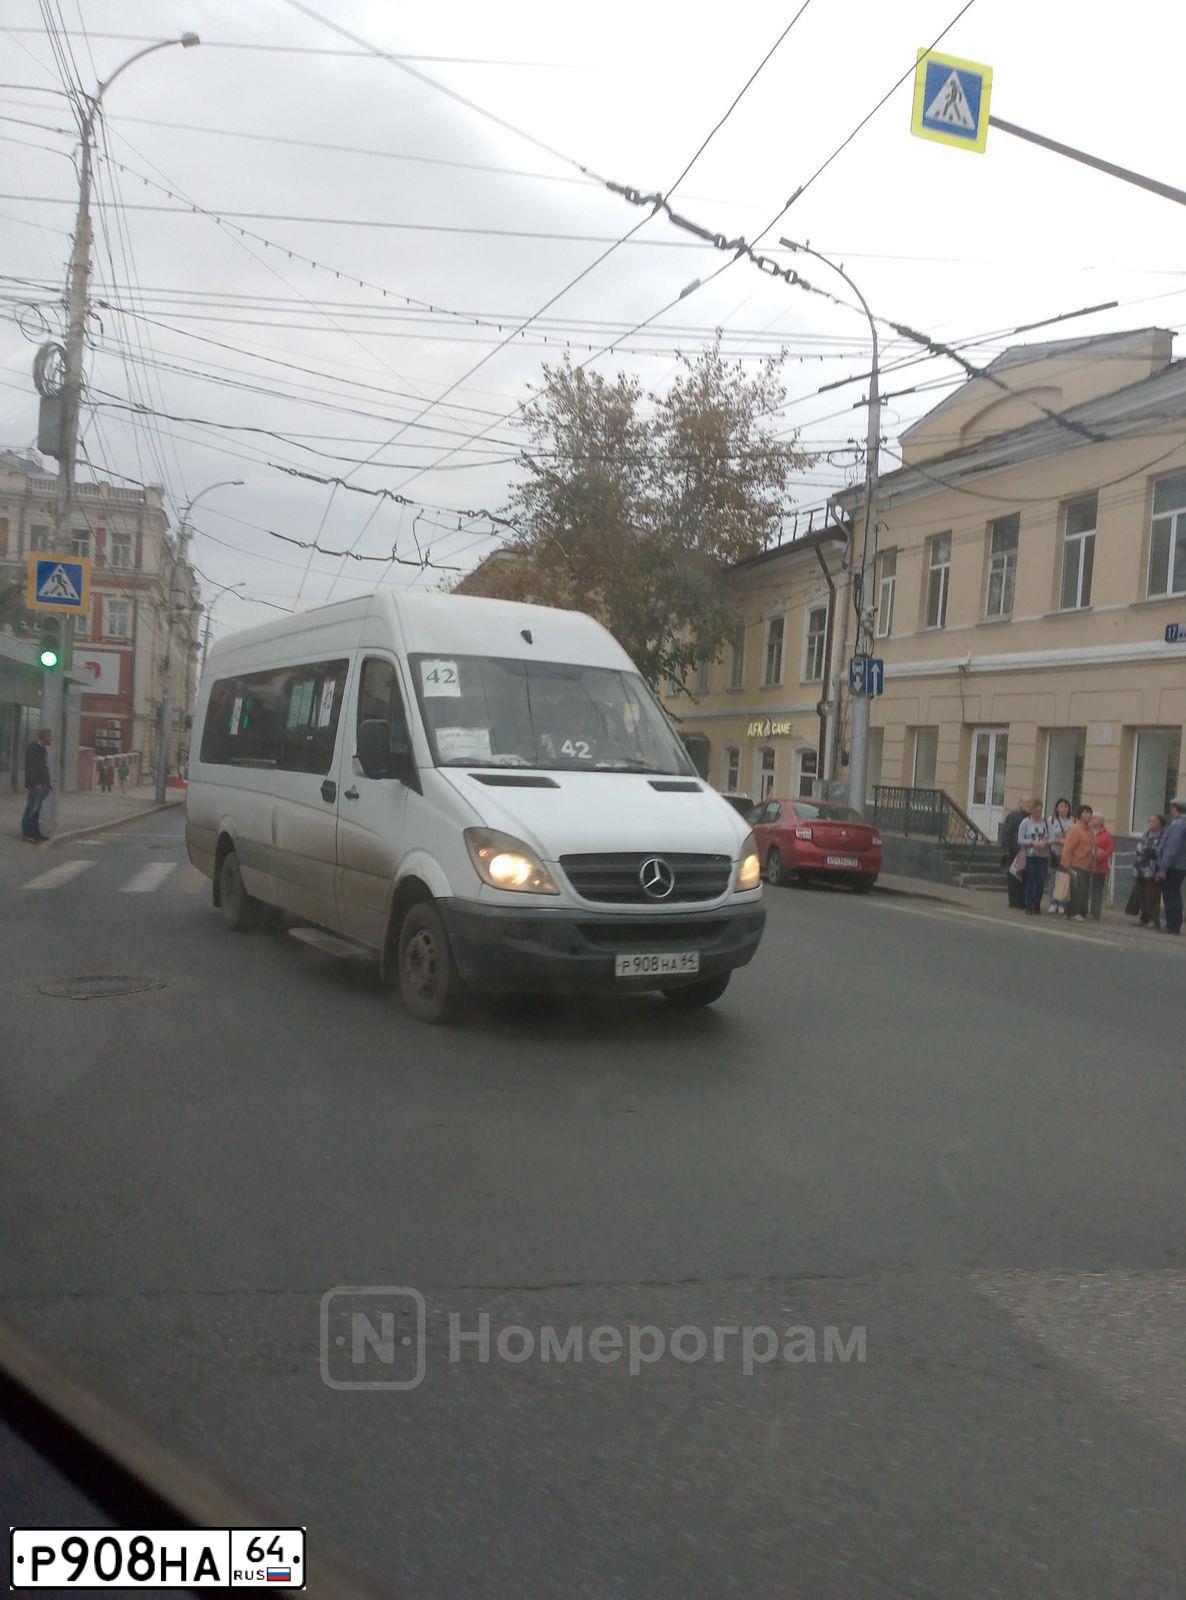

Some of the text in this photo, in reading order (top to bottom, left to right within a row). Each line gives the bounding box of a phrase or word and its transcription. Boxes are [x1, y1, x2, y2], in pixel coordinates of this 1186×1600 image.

[426, 669, 456, 684] 42
[747, 722, 763, 737] AFK
[561, 739, 592, 758] 42
